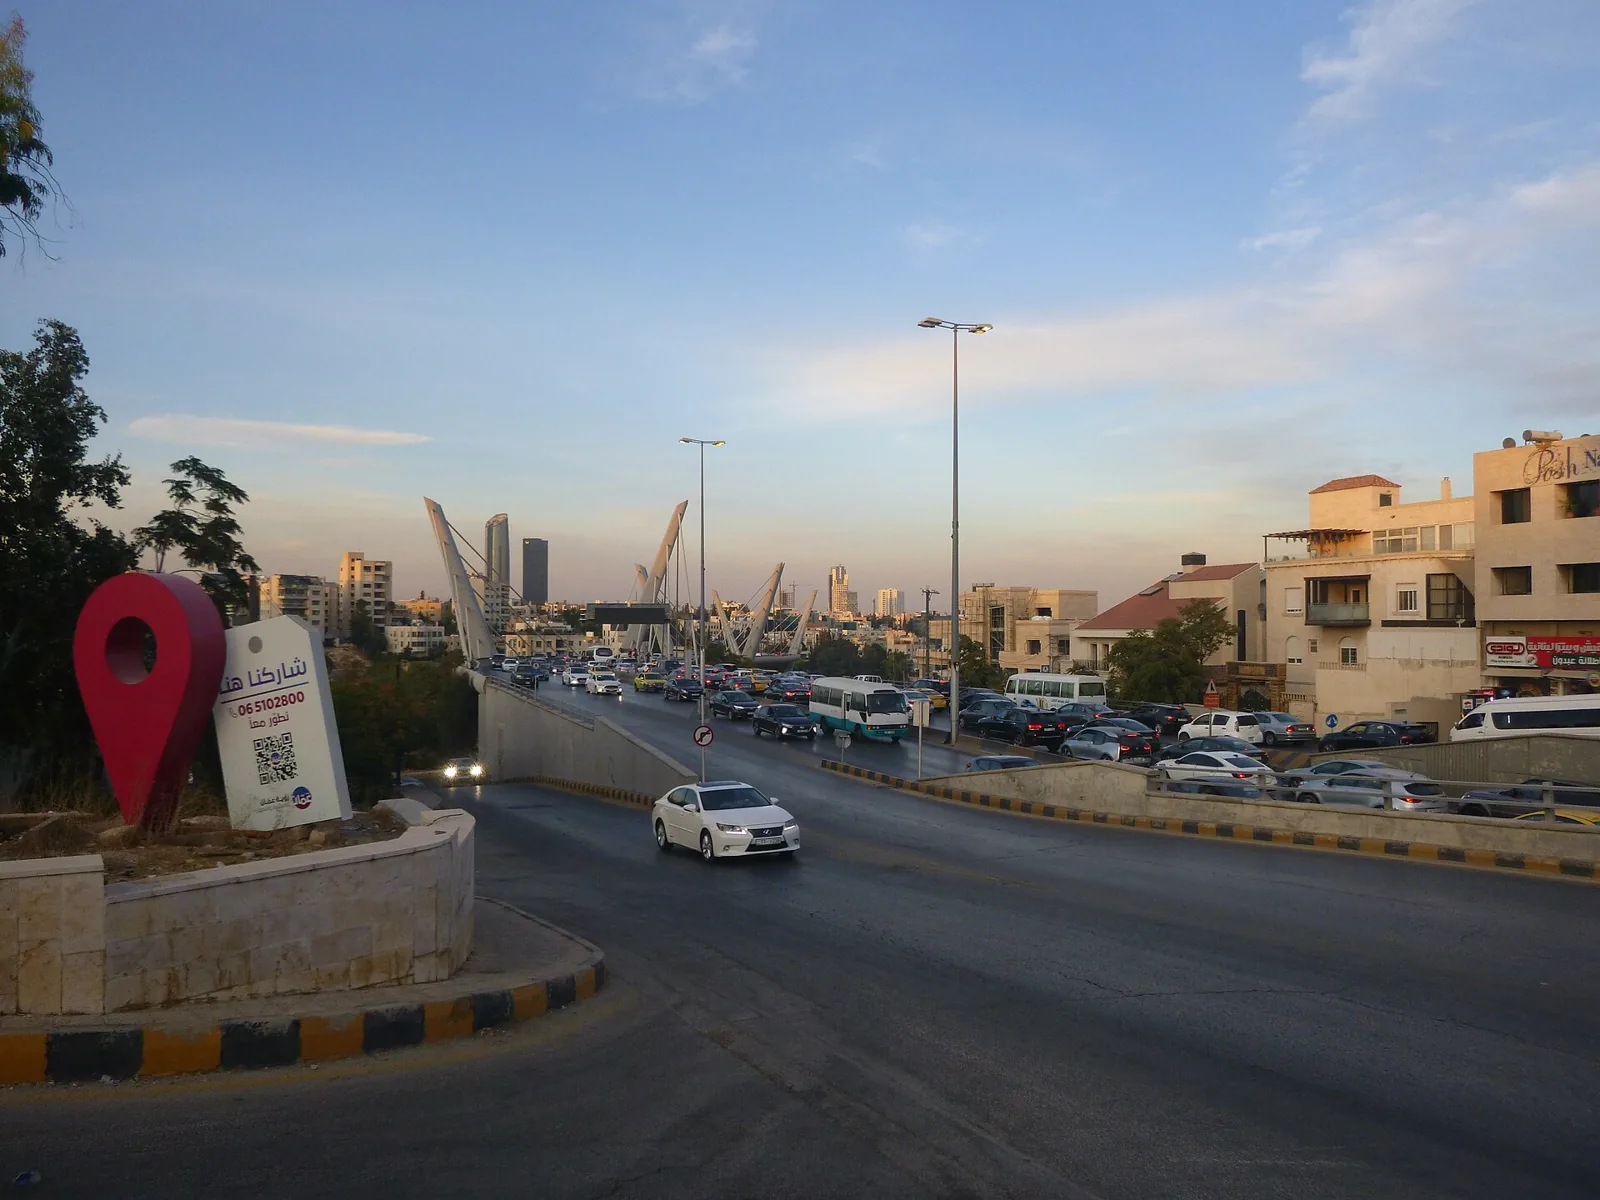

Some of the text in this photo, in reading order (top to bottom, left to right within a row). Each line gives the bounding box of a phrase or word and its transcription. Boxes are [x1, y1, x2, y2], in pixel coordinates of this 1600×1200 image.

[1523, 447, 1578, 486] Posh
[220, 657, 307, 694] شاركنا هن
[1552, 656, 1577, 665] عبدون
